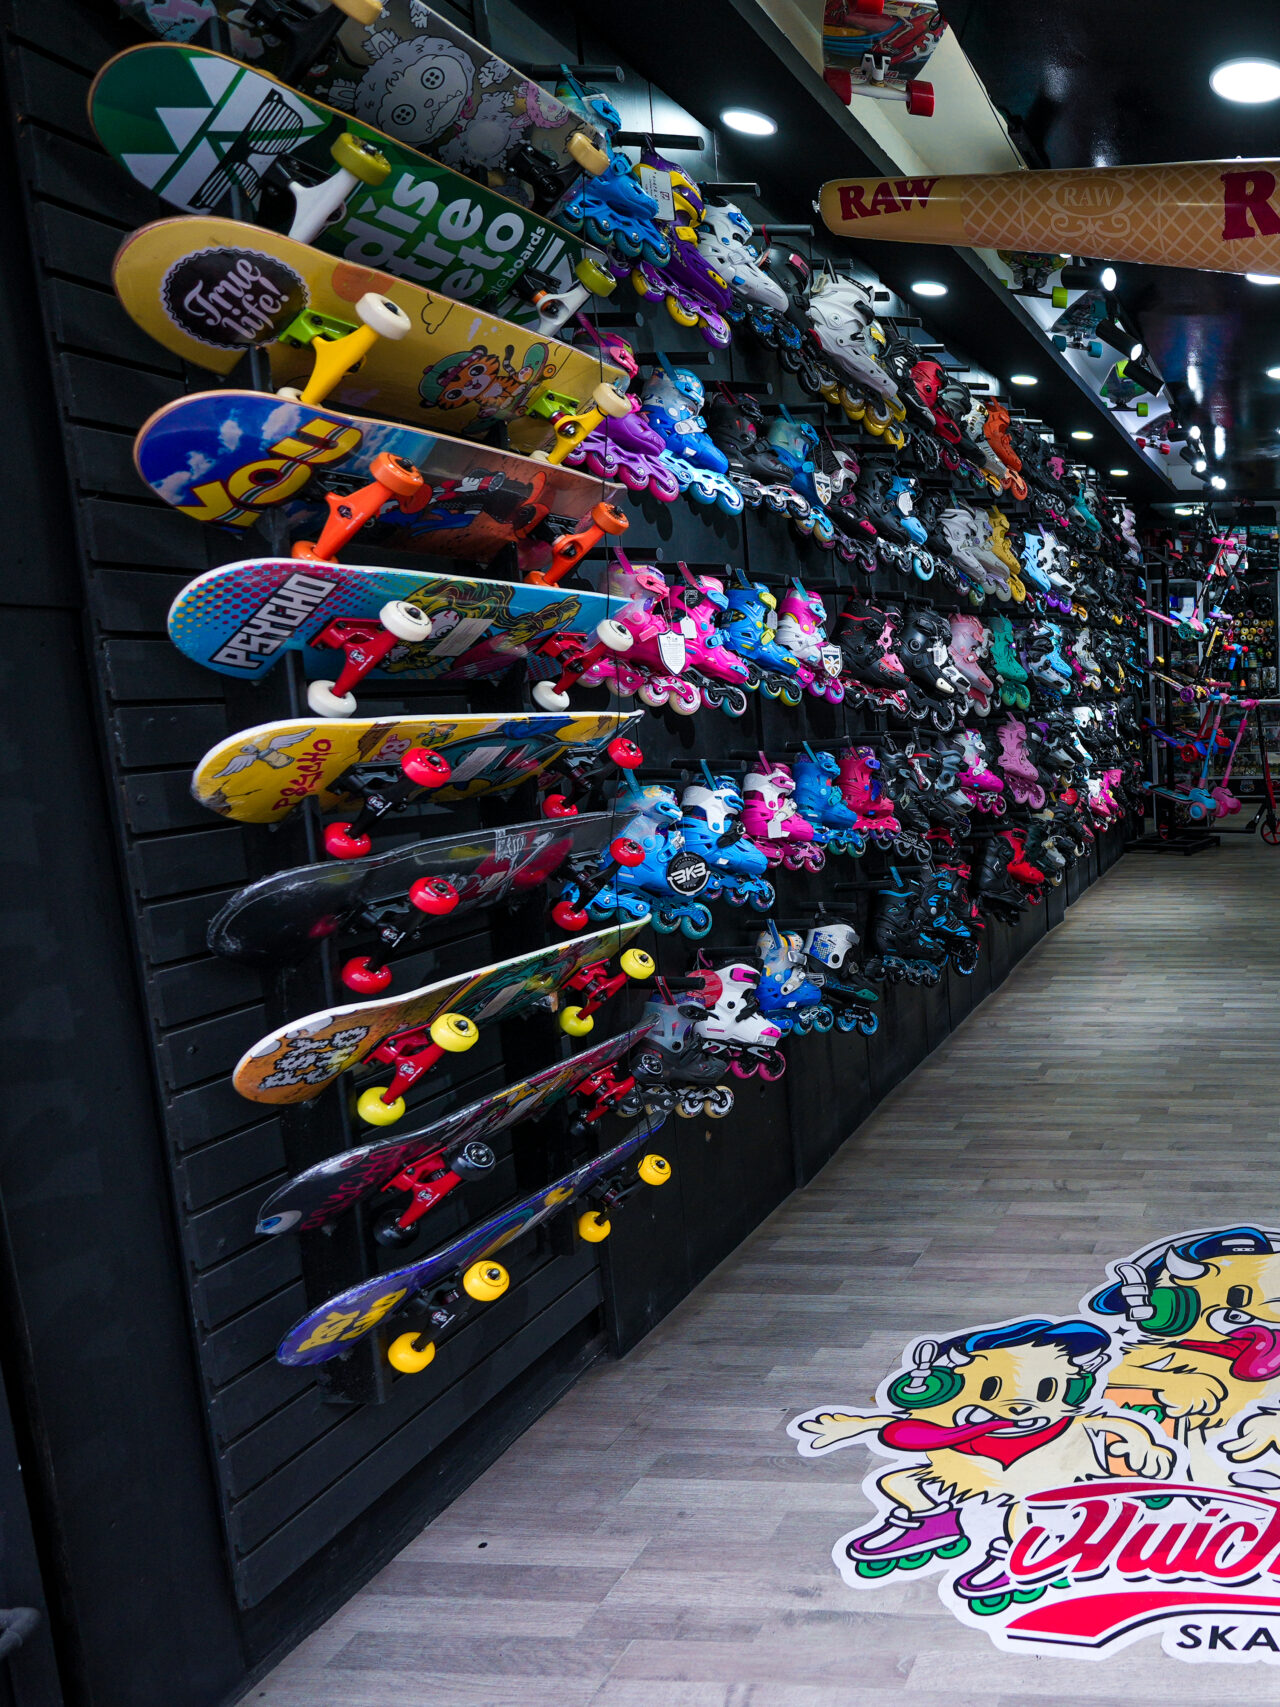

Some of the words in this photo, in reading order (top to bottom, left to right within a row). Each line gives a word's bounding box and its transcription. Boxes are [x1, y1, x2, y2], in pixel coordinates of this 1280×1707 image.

[837, 178, 940, 220] RAW
[1063, 186, 1118, 207] RAW
[183, 258, 262, 326] True
[221, 275, 290, 340] life!
[175, 417, 364, 528] YOU
[210, 573, 340, 669] PSYCHO
[272, 738, 333, 811] PSYCHO
